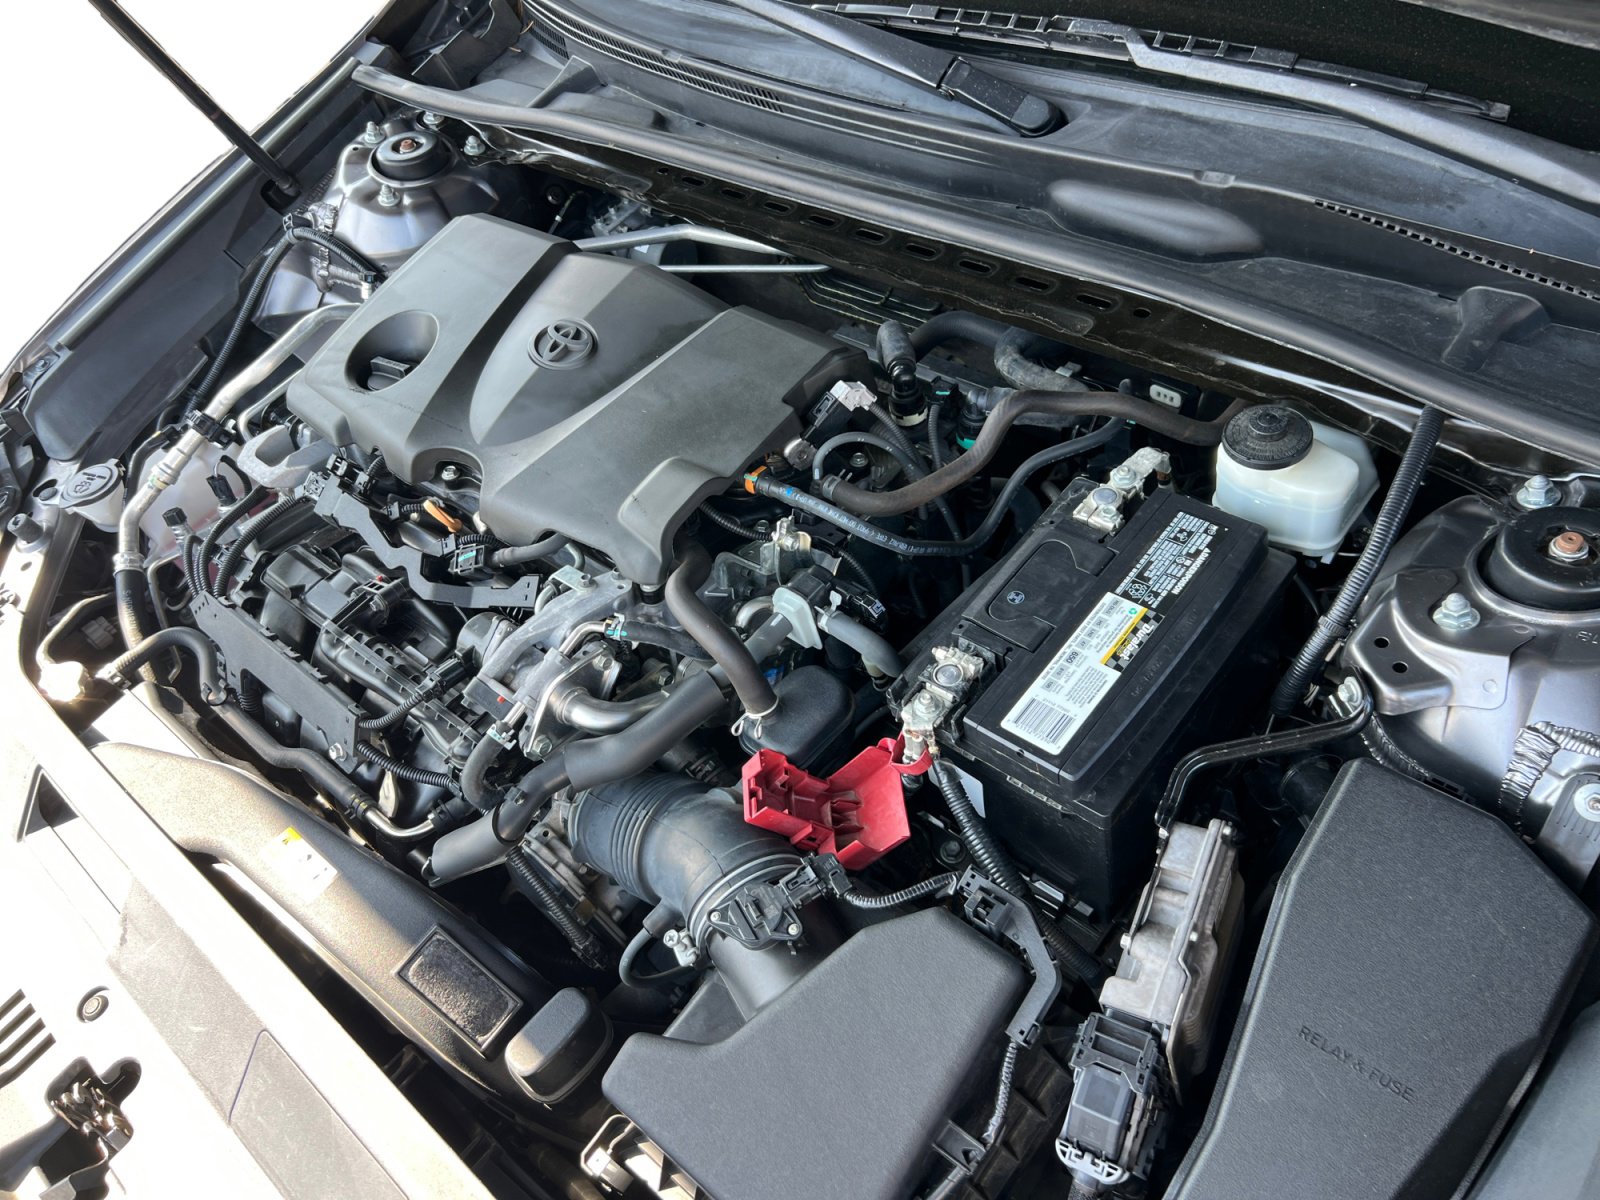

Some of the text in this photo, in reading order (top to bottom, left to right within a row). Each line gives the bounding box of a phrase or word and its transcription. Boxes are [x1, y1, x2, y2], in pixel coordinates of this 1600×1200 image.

[1118, 621, 1154, 661] Duralast
[1299, 1024, 1353, 1063] RELAY
[1368, 1067, 1417, 1103] FUSE
